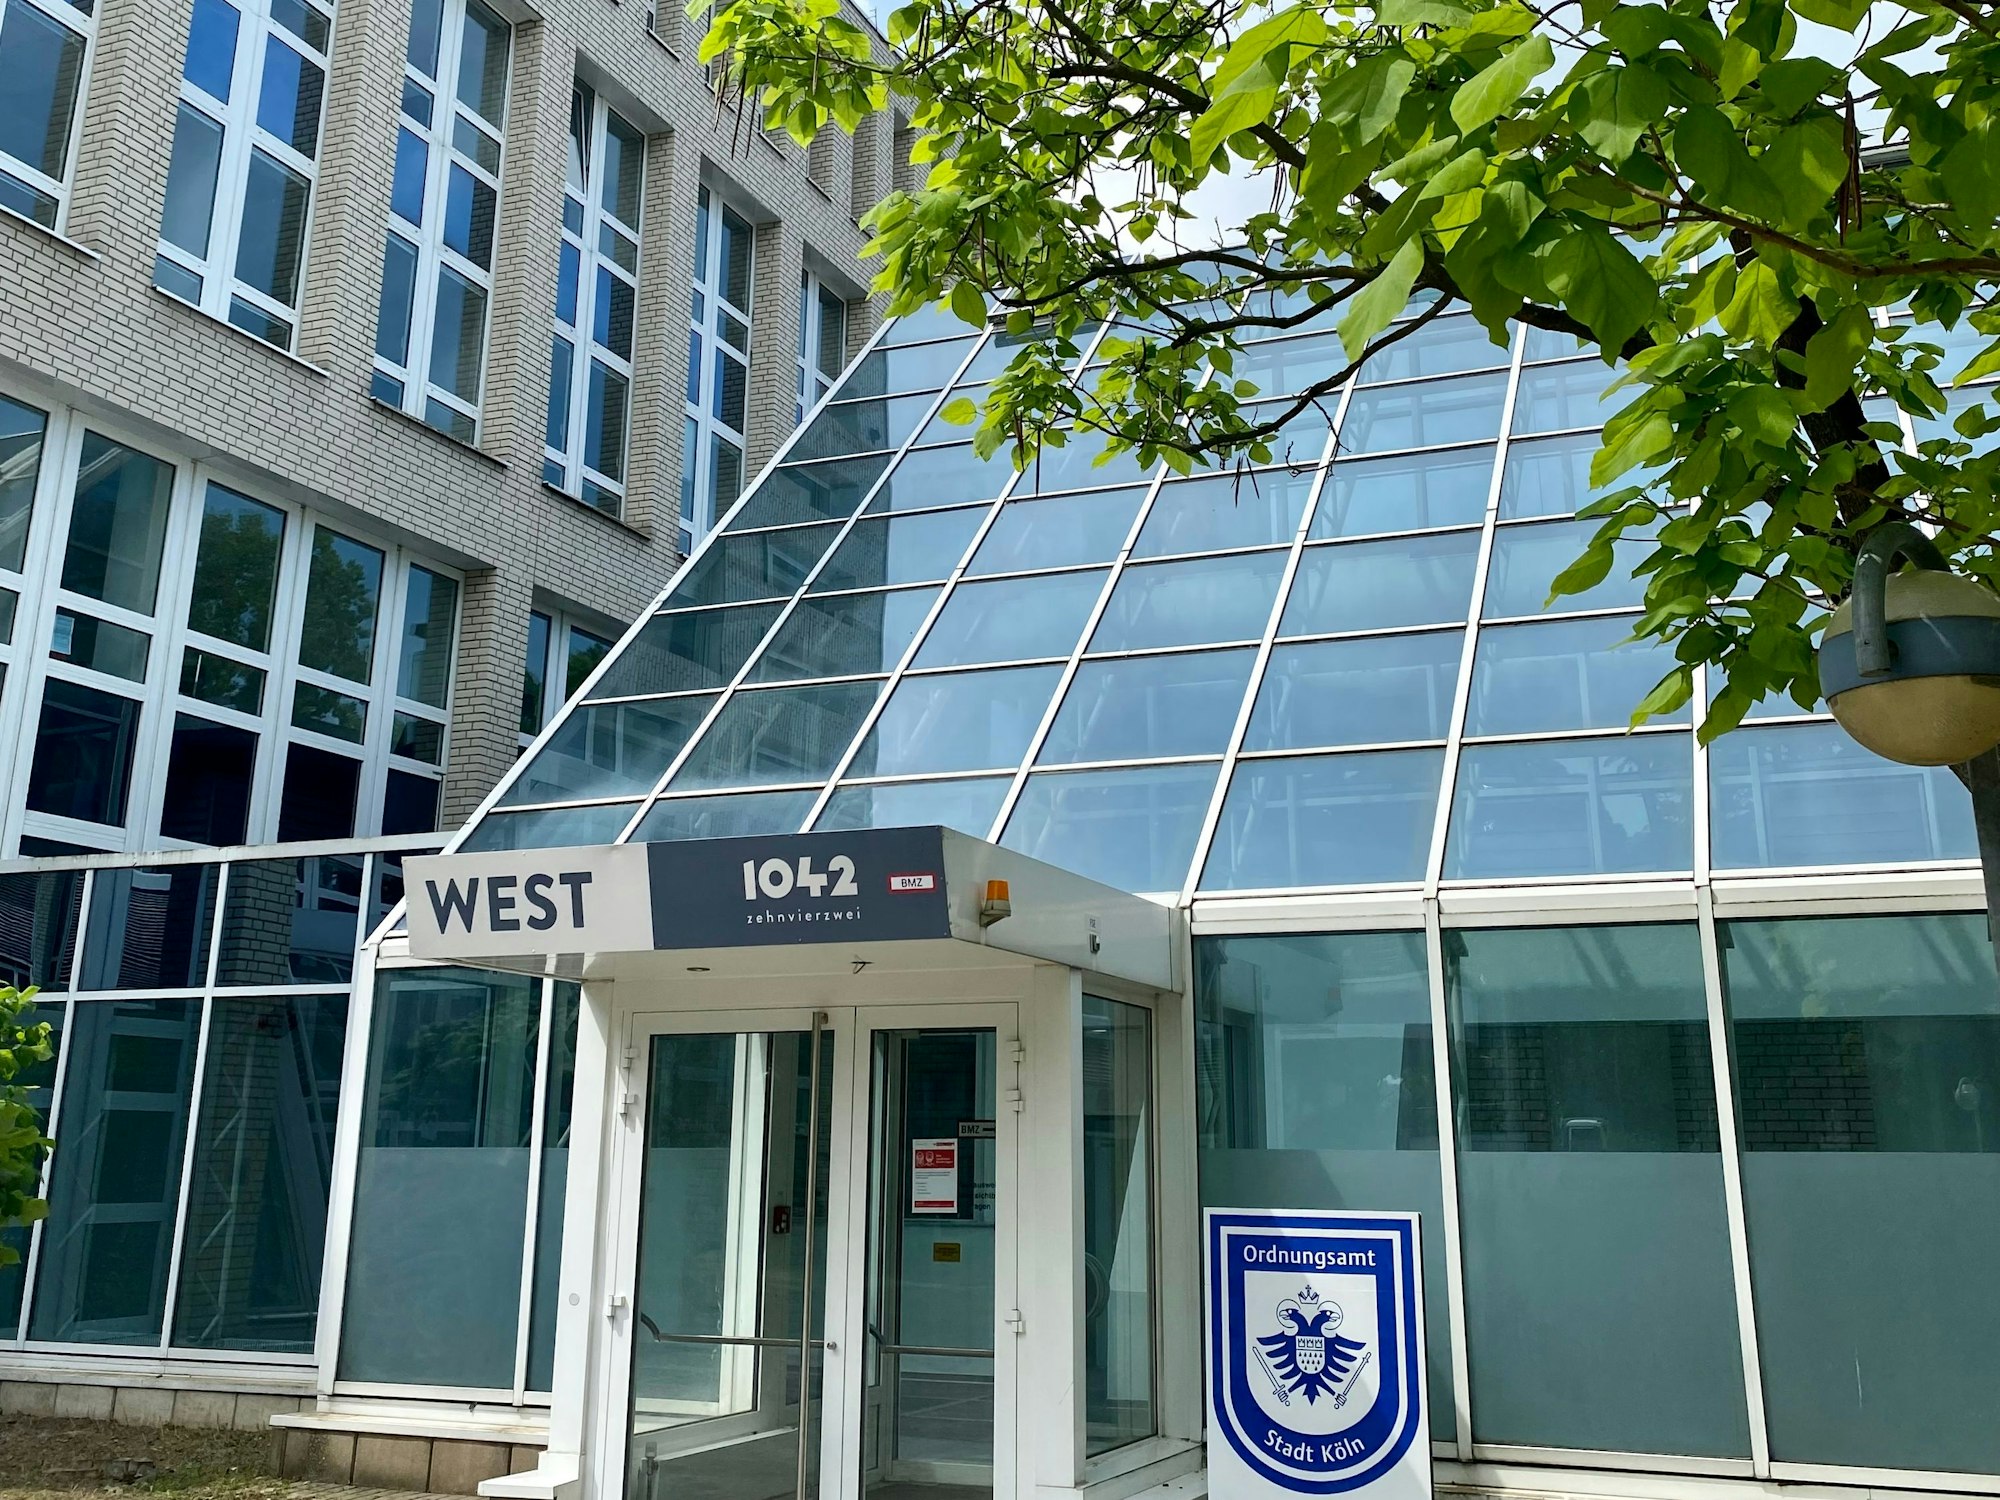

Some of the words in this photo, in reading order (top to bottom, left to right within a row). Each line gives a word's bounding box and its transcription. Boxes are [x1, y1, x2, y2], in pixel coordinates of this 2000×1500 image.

[743, 854, 859, 901] 1042
[901, 877, 923, 888] BMZ
[425, 871, 593, 935] WEST
[746, 906, 862, 925] zehnvierzwei
[961, 1125, 980, 1134] BMZ
[1243, 1244, 1377, 1270] Ordnungsamt
[1263, 1428, 1315, 1463] Stadt
[1321, 1438, 1366, 1464] Köln
